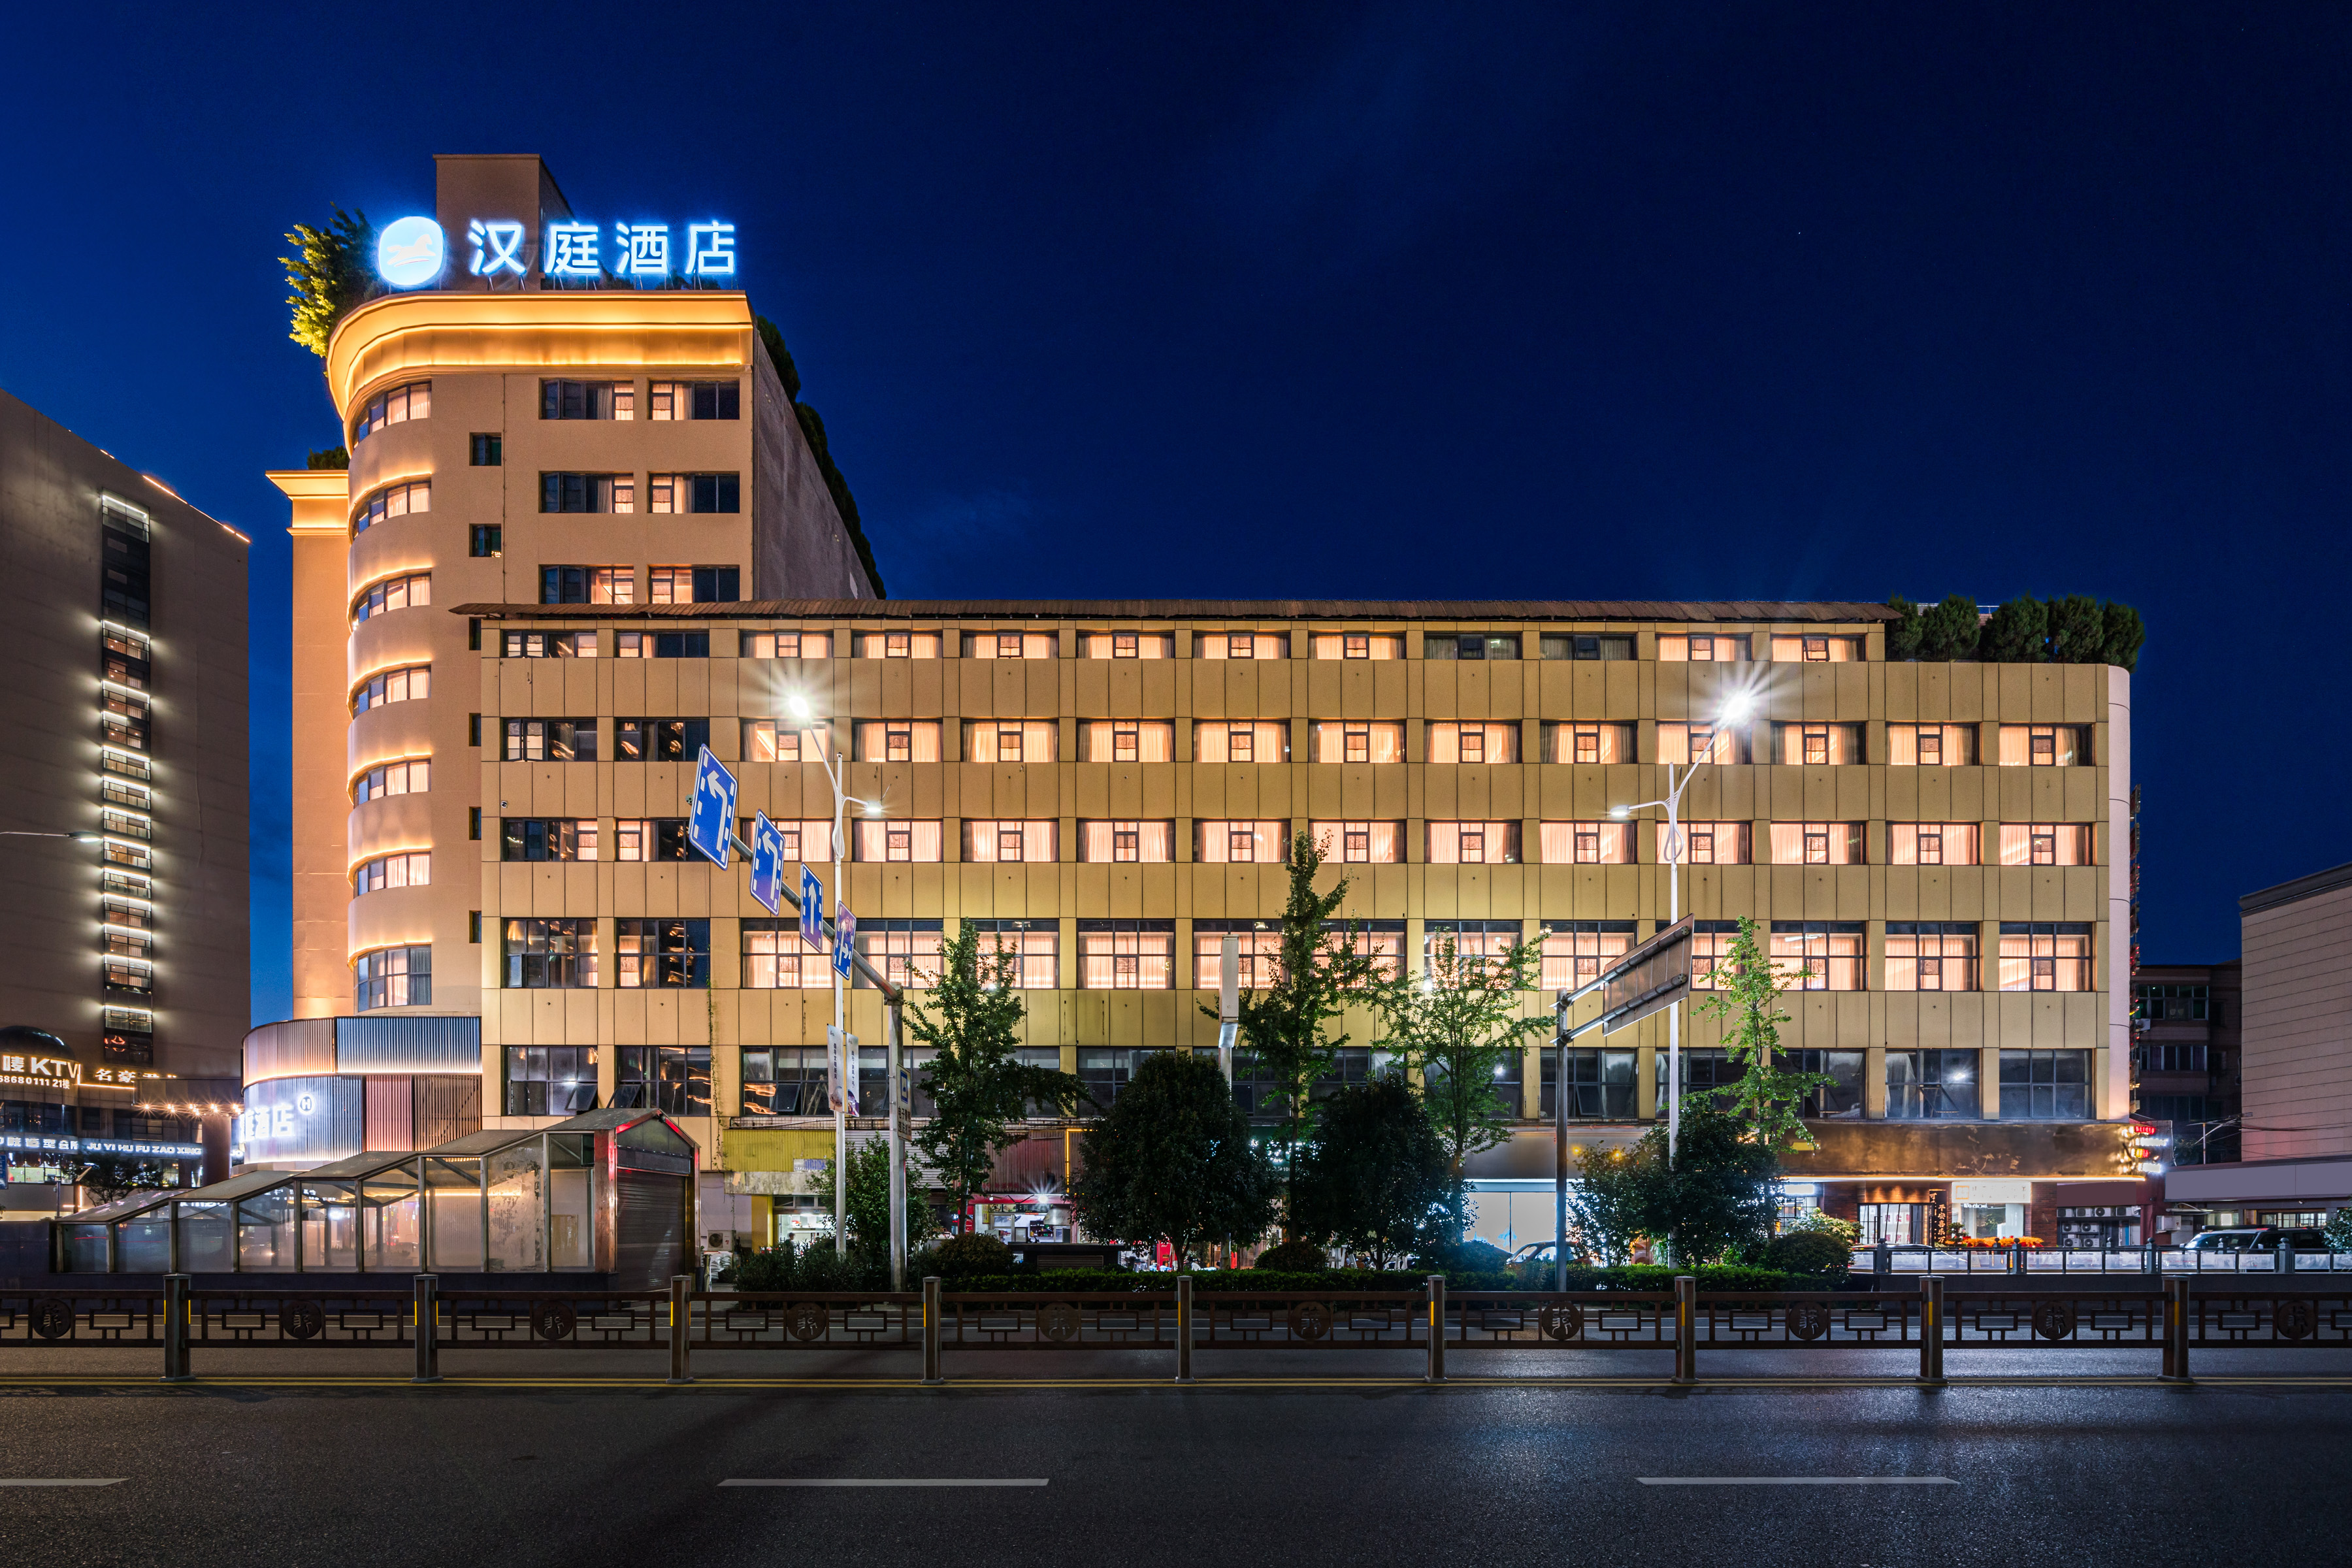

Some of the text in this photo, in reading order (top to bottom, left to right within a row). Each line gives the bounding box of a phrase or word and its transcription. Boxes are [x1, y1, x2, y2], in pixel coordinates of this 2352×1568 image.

[469, 221, 735, 275] 汉庭酒店
[3, 1054, 78, 1079] 唛 KTV
[177, 1147, 202, 1155] XING
